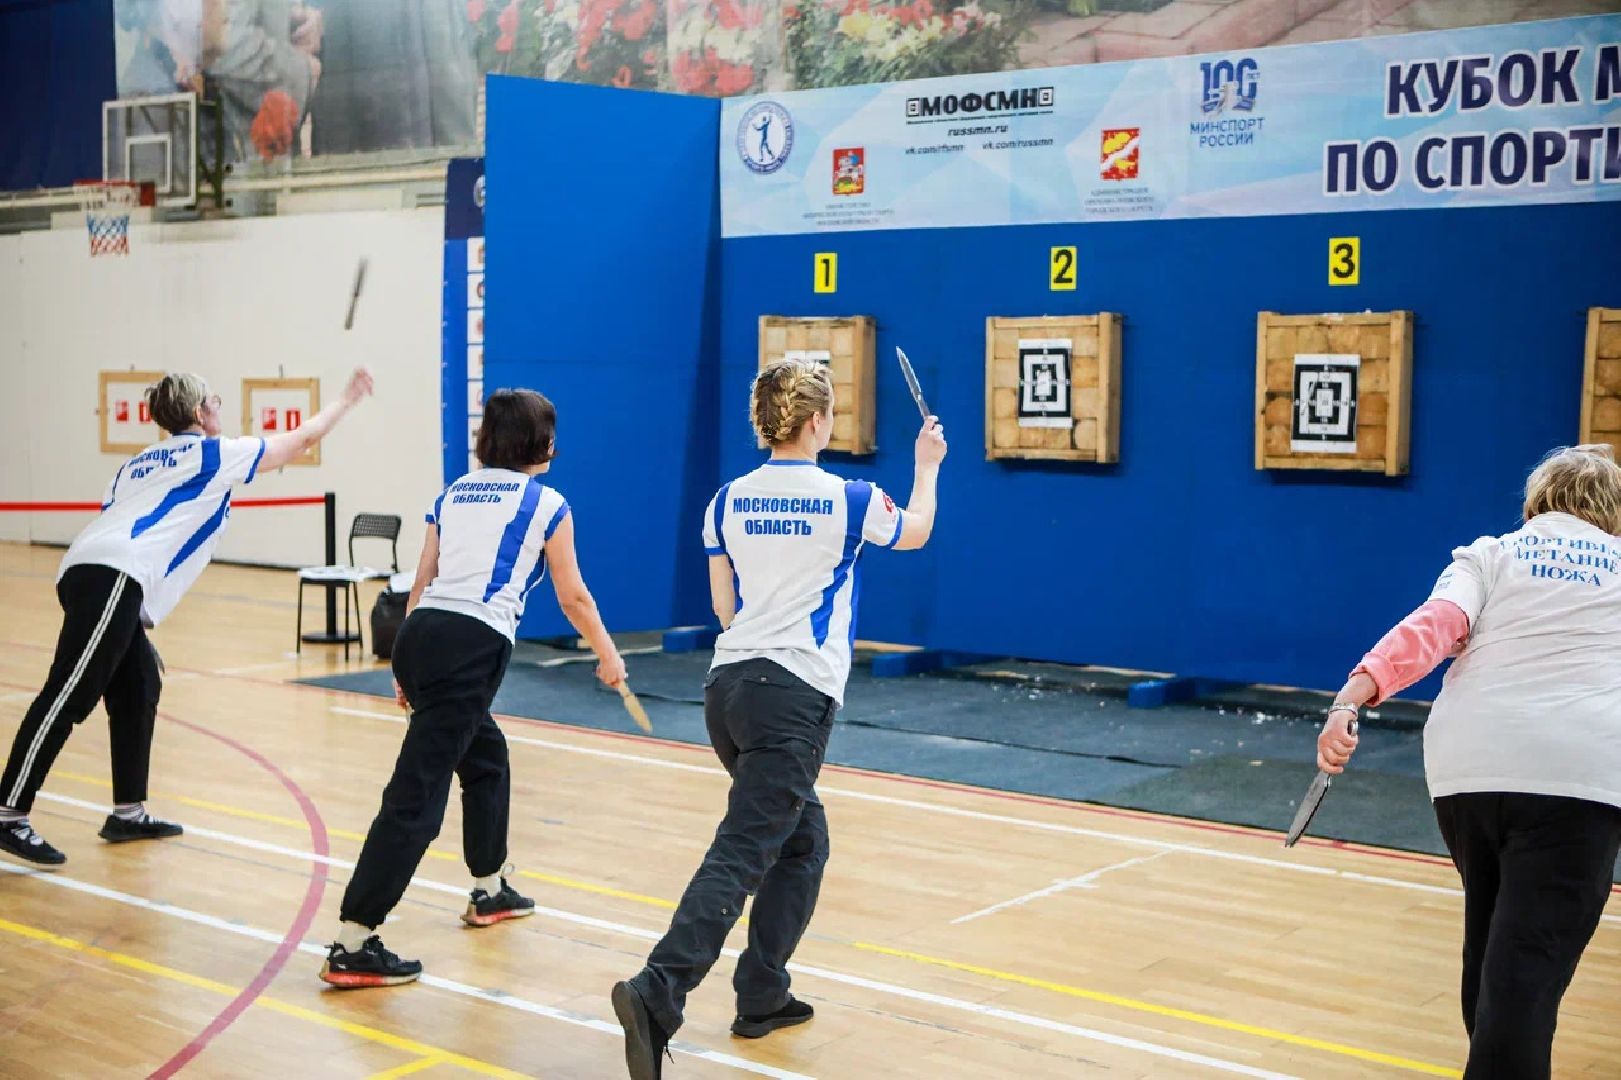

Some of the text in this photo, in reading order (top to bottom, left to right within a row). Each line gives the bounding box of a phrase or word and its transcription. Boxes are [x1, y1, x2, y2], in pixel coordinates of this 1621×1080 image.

[1387, 48, 1581, 116] КУБОК
[947, 124, 1009, 138] russmn.ru
[1190, 117, 1265, 135] МИНСПОРТ
[1199, 132, 1254, 149] РОССИИ
[1327, 140, 1398, 193] ПО
[1053, 249, 1073, 284] 2
[1332, 243, 1355, 279] 3
[820, 258, 830, 287] 1
[453, 494, 502, 504] ОБЛАСТЬ
[732, 497, 833, 515] МОСКОВСКАЯ
[744, 520, 812, 536] ОБЛАСТЬ
[1532, 564, 1601, 587] НОЖА
